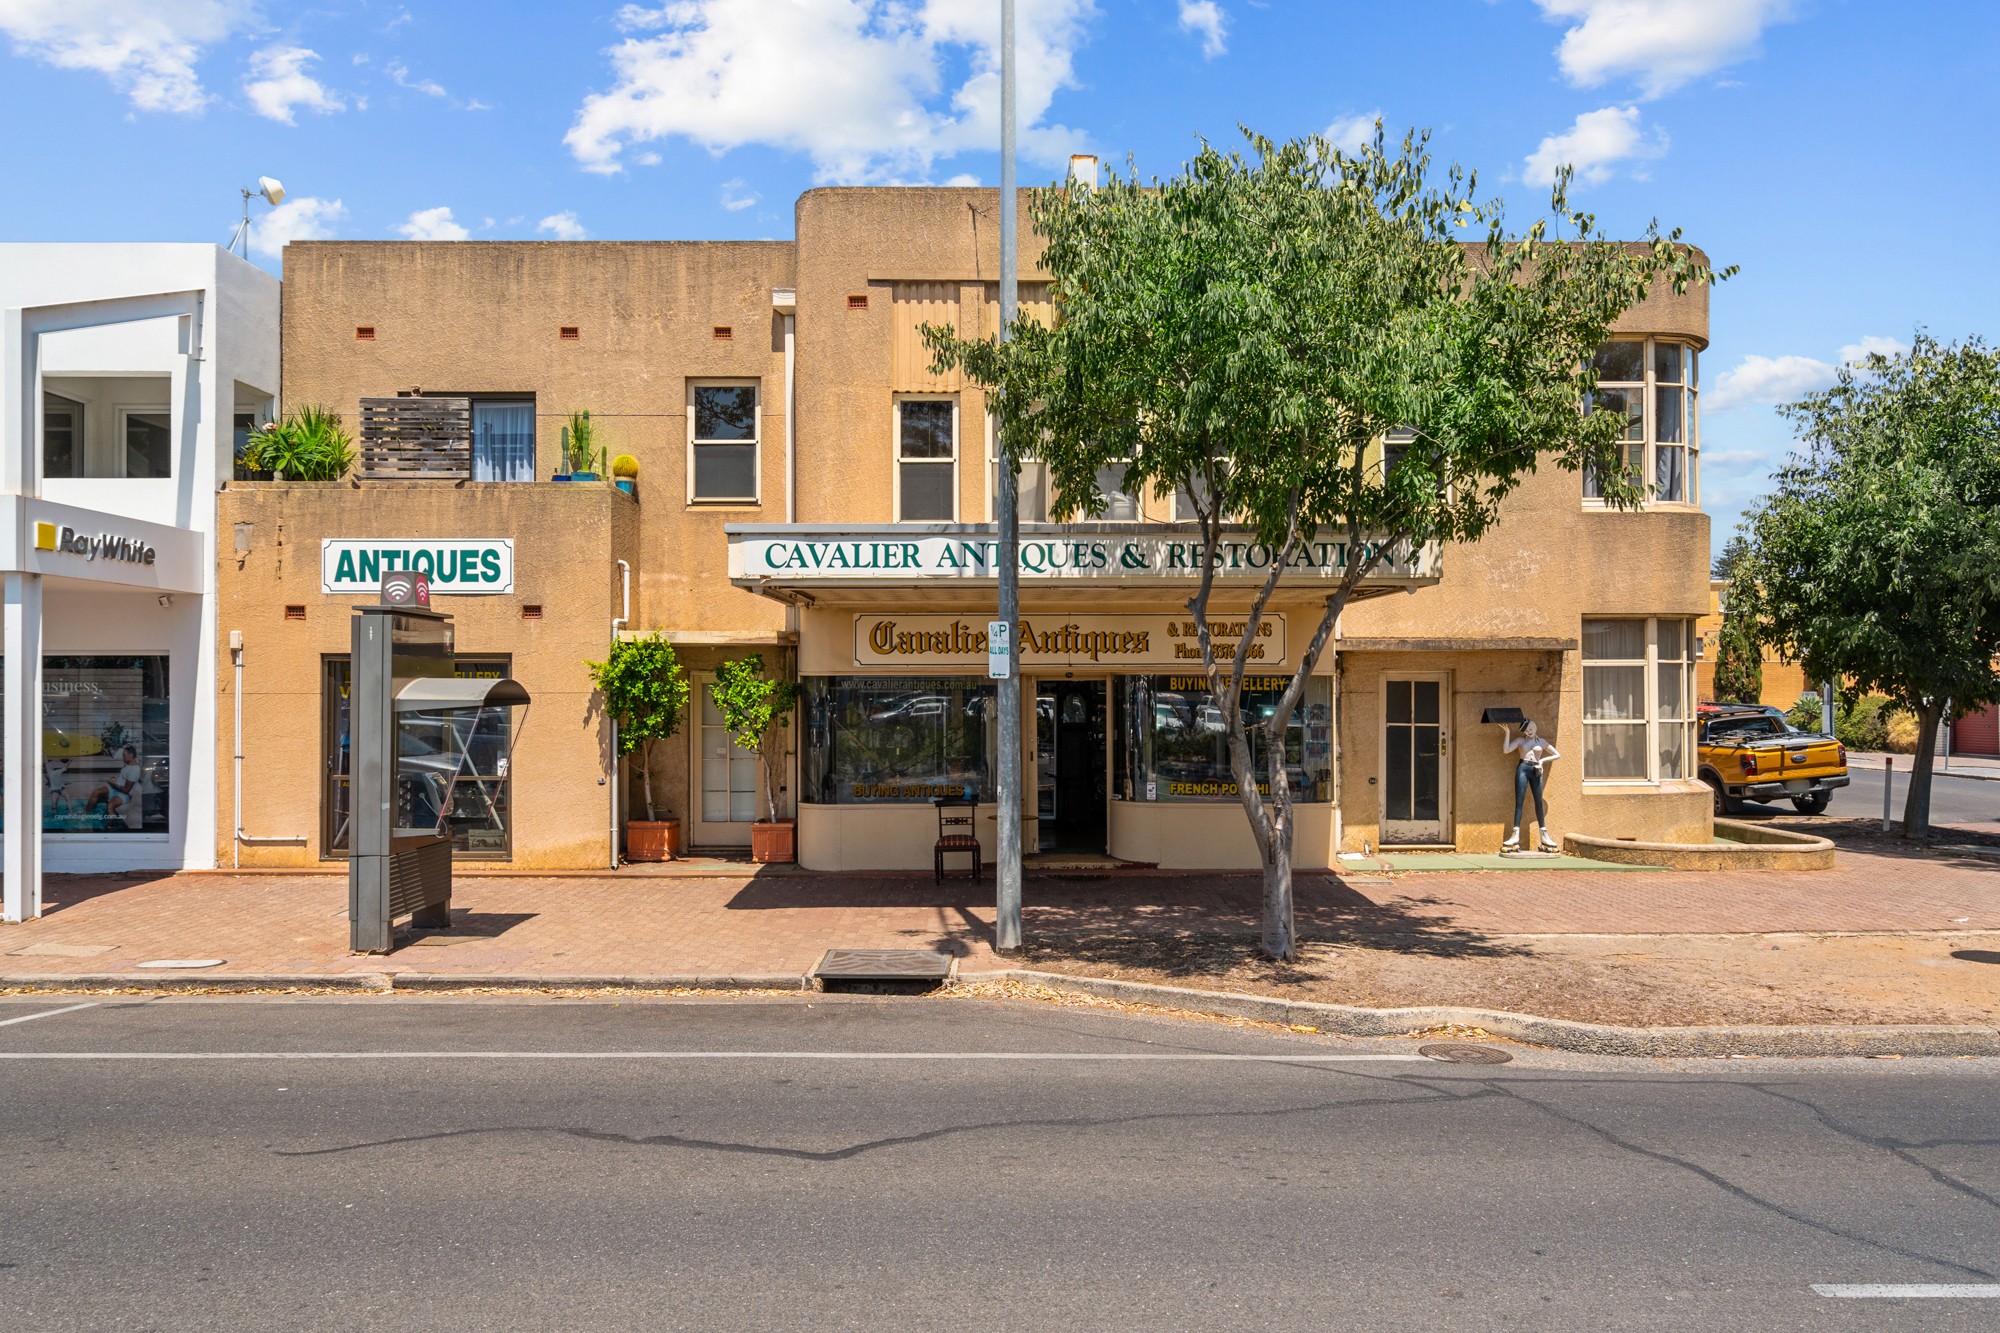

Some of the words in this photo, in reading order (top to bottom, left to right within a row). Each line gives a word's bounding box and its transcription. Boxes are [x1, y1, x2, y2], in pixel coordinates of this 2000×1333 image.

[765, 543, 922, 568] CAVALIER
[936, 543, 1107, 574] ANTQUES
[1120, 543, 1151, 569] &
[334, 549, 501, 585] ANTIQUES
[1167, 621, 1179, 637] &
[1182, 622, 1272, 638] RETORATNS
[869, 620, 989, 655] Cavalie
[1019, 620, 1150, 662] Antiques
[1174, 643, 1203, 659] Phon
[841, 679, 977, 692] www.cavalierantiques.com.au
[1220, 677, 1287, 691] EELLERY
[853, 784, 899, 797] BUYING
[903, 784, 965, 797] ANTIQUES
[1170, 783, 1219, 796] FRENCH
